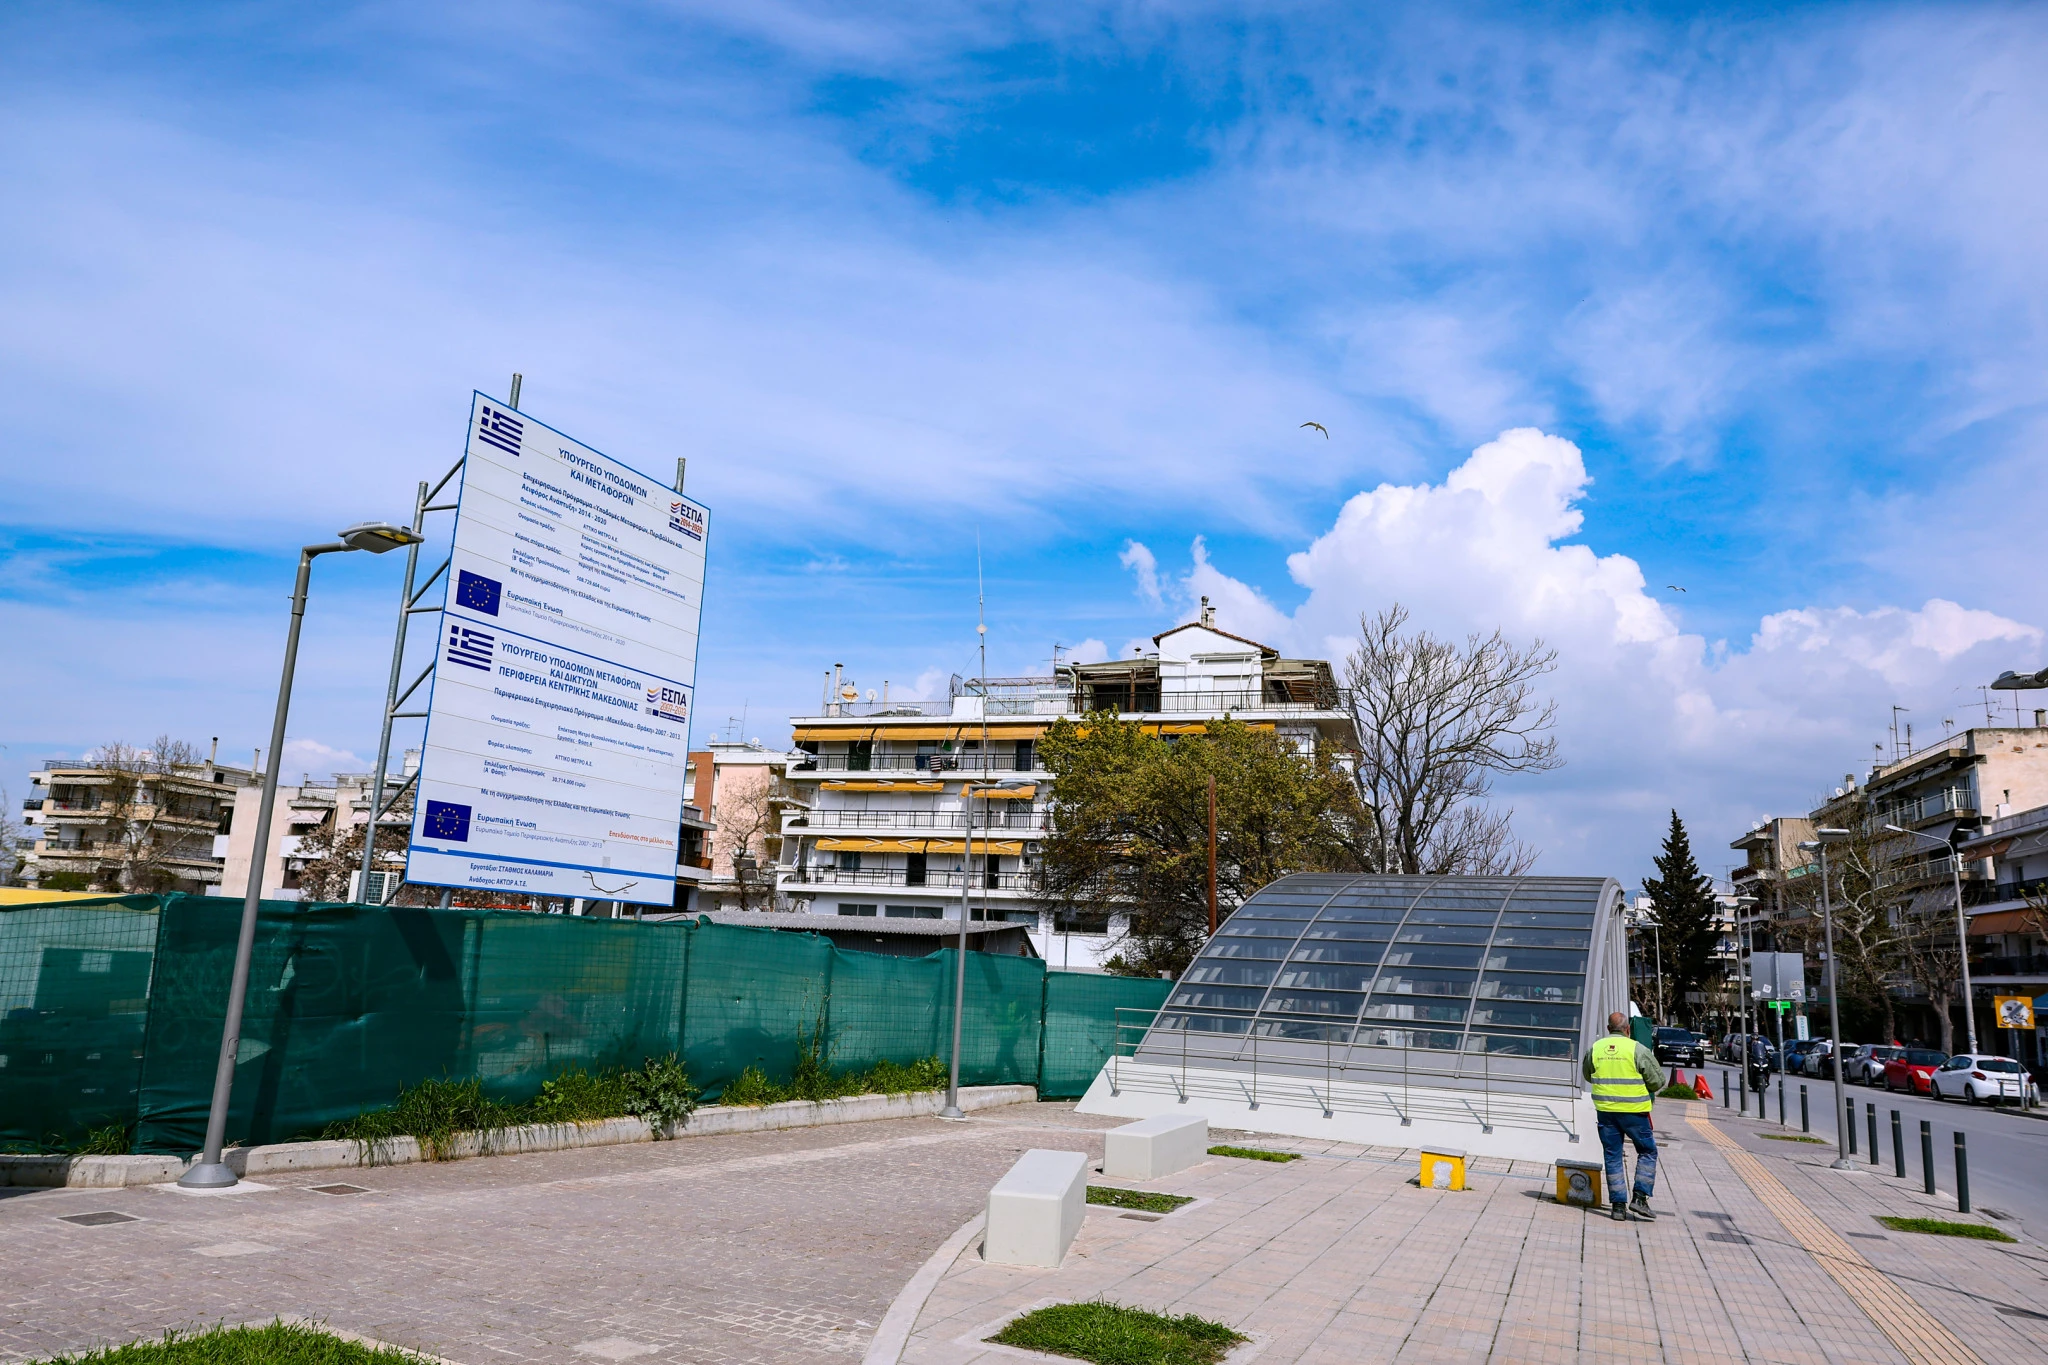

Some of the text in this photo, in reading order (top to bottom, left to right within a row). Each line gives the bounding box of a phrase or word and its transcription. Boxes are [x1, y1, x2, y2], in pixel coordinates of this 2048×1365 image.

[559, 448, 647, 498] ΥΠΟΥΡΓΕΙΟ ΥΠΟΔΟΜΩΝ
[570, 469, 634, 506] ΚΑΙ ΜΕΤΑΦΟΡΩΝ
[680, 504, 703, 525] ΕΣΠΑ
[507, 590, 564, 616] Ευρωπαϊκή Ένωση
[501, 642, 641, 690] ΥΠΟΥΡΓΕΙΟ ΥΠΟΔΟΜΩΝ ΜΕΤΑΦΟΡΩΝ
[499, 666, 638, 711] ΠΕΡΙΦΕΡΕΙΑ ΚΕΝΤΡΙΚΗΣ ΜΑΚΕΔΟΝΙΑΣ
[550, 668, 598, 689] ΚΑΙ ΔΙΚΤΥΩΝ
[661, 687, 687, 707] ΕΣΠΑ
[494, 687, 534, 704] Περιφερειακό
[534, 697, 574, 713] Επιχειρησιακό
[574, 707, 604, 721] Πρόγραμμα
[605, 716, 634, 729] «Μακεδονία
[636, 723, 655, 734] Θράκη»
[655, 728, 666, 736] 2007
[669, 732, 680, 740] 2013
[477, 813, 537, 830] Ευρωπαϊκή Ένωση
[468, 876, 495, 885] Ανάδοχος:
[496, 878, 513, 886] ΑΚΤΩΡ
[470, 863, 554, 877] Εργοτάξιο: ΣΤΑΘΜΟΣ ΚΑΛΑΜΑΡΙΑ
